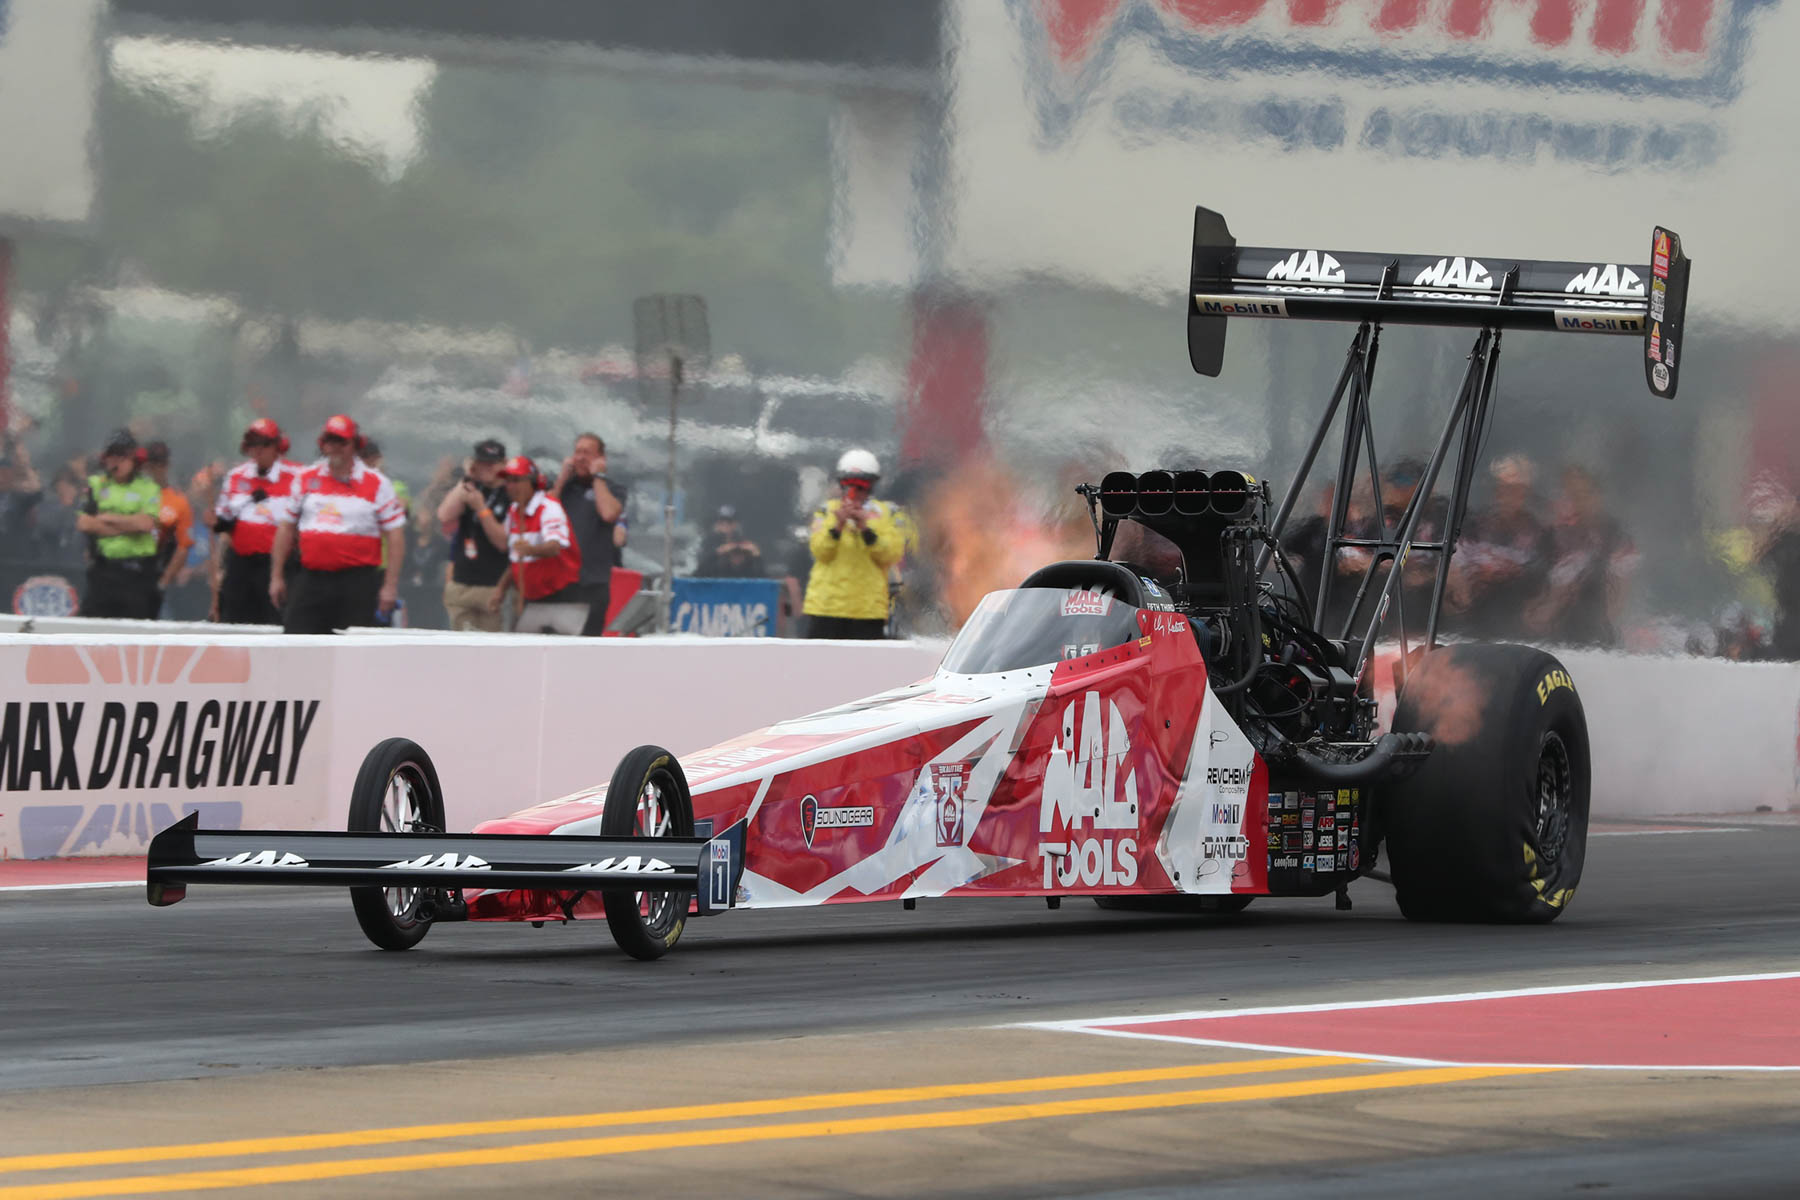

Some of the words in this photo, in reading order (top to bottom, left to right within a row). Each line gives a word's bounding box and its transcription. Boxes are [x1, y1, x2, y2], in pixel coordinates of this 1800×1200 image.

[1266, 250, 1345, 283] MAC
[1413, 257, 1493, 290] MAC
[1565, 264, 1644, 297] MAC
[1266, 285, 1344, 295] TOOLS
[1413, 291, 1491, 301] TOOLS
[1204, 301, 1258, 314] Mobil
[1564, 299, 1643, 308] TOOLS
[1562, 317, 1616, 330] Mobil
[1065, 590, 1102, 606] MAC
[1065, 606, 1102, 614] TOOLS
[87, 700, 320, 790] DRAGWAY
[1039, 691, 1138, 833] MAC
[1207, 768, 1245, 784] REVCHEM
[817, 810, 872, 824] SOUNDGEAR
[1212, 804, 1231, 824] Mobil
[1233, 804, 1240, 824] 1
[712, 845, 728, 860] Mobil
[1204, 836, 1246, 858] DAYCO
[1038, 838, 1138, 889] TOOLS
[716, 865, 722, 900] 1
